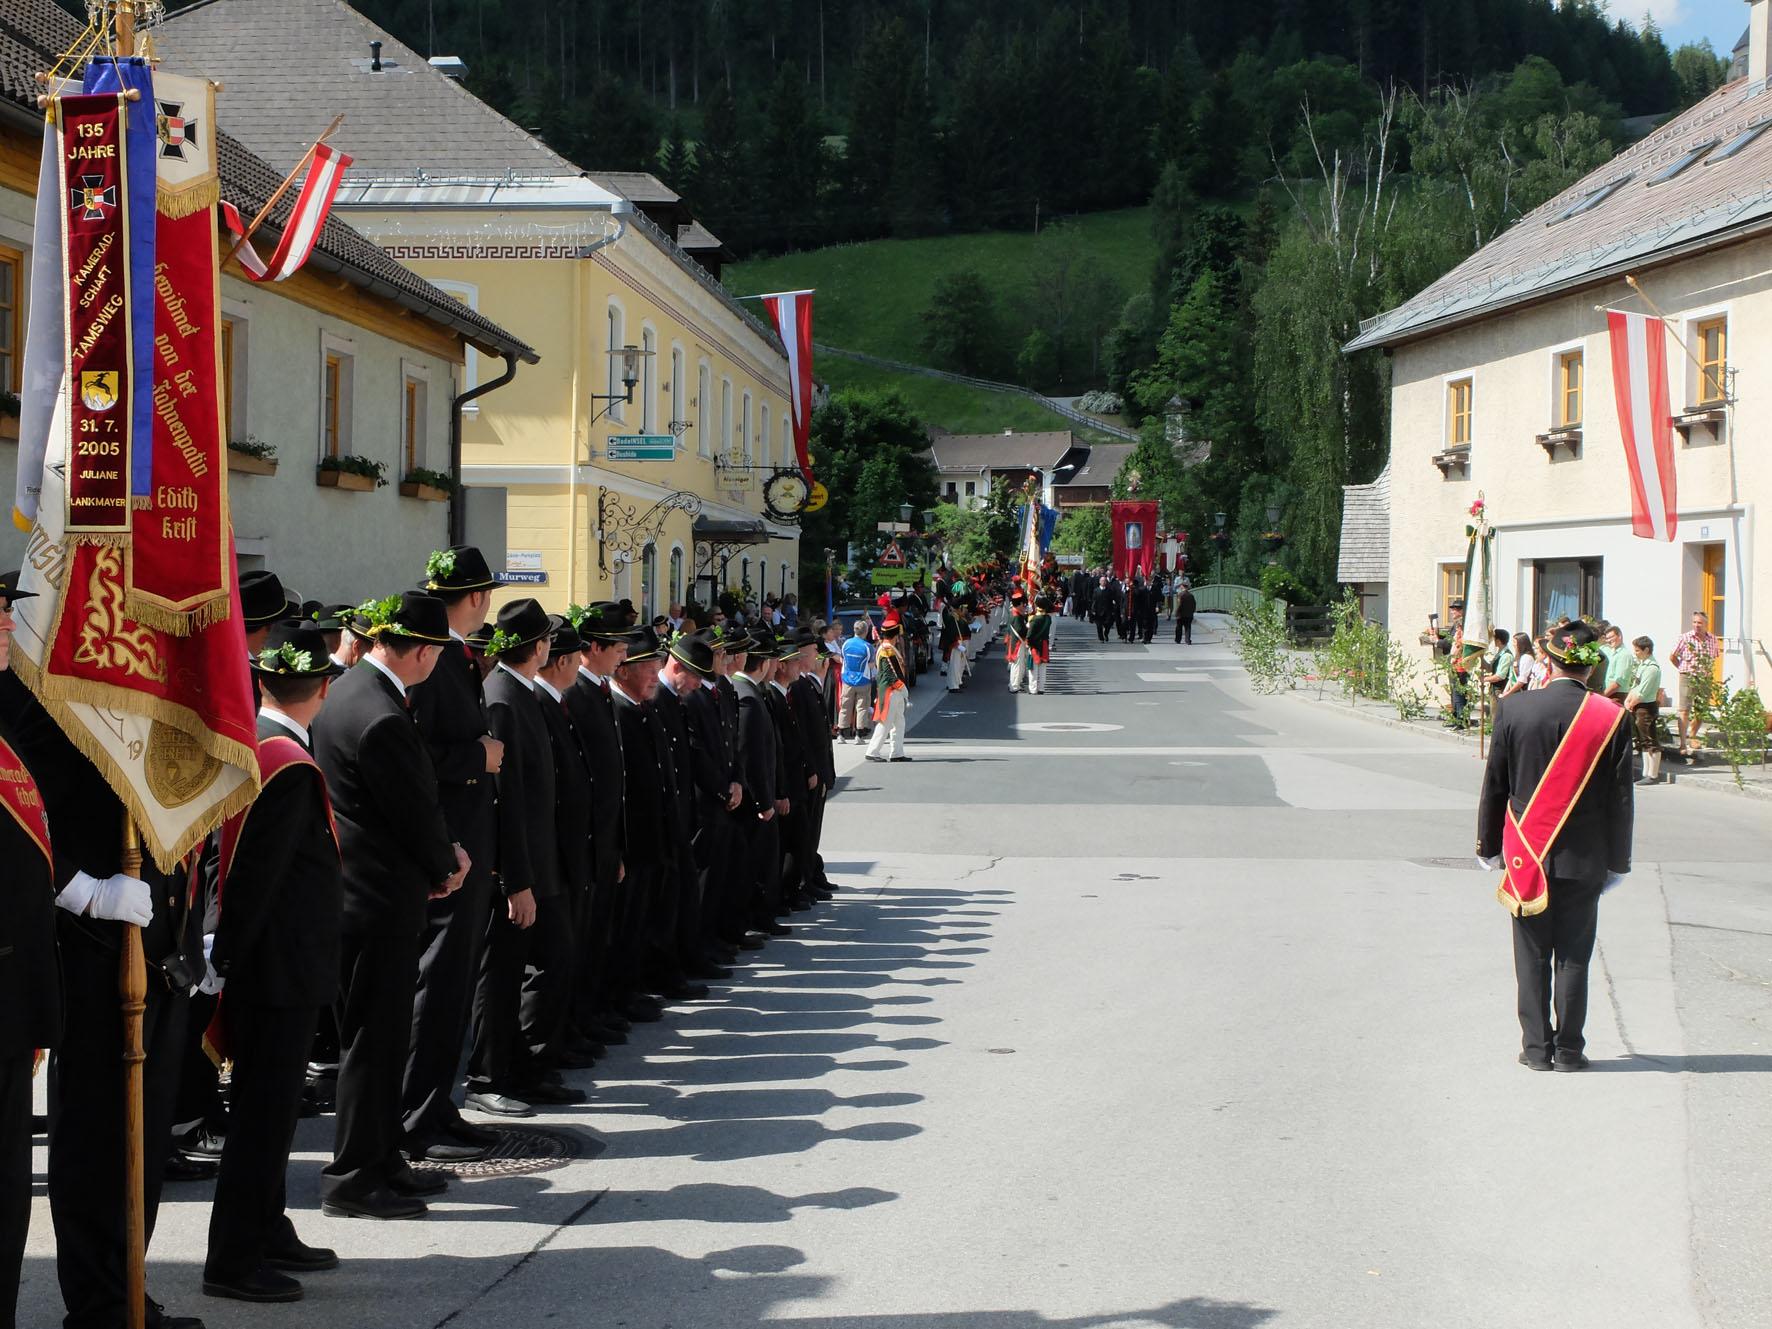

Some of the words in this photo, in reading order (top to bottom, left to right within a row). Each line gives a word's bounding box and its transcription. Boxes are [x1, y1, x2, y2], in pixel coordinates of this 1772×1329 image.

[77, 123, 104, 138] 135
[67, 145, 116, 159] JAHRE
[74, 231, 116, 286] KAMERAD-
[79, 264, 112, 308] SCHAFT
[72, 294, 123, 359] TAMSWEG
[155, 333, 179, 367] von
[174, 369, 198, 398] der
[79, 418, 99, 433] 31.
[104, 419, 119, 433] 7.
[78, 441, 120, 456] 2005
[79, 469, 119, 480] JULIANE
[70, 496, 126, 507] LANKMAYER
[157, 485, 198, 512] Edith
[498, 572, 542, 583] Murweg
[127, 739, 144, 761] 19
